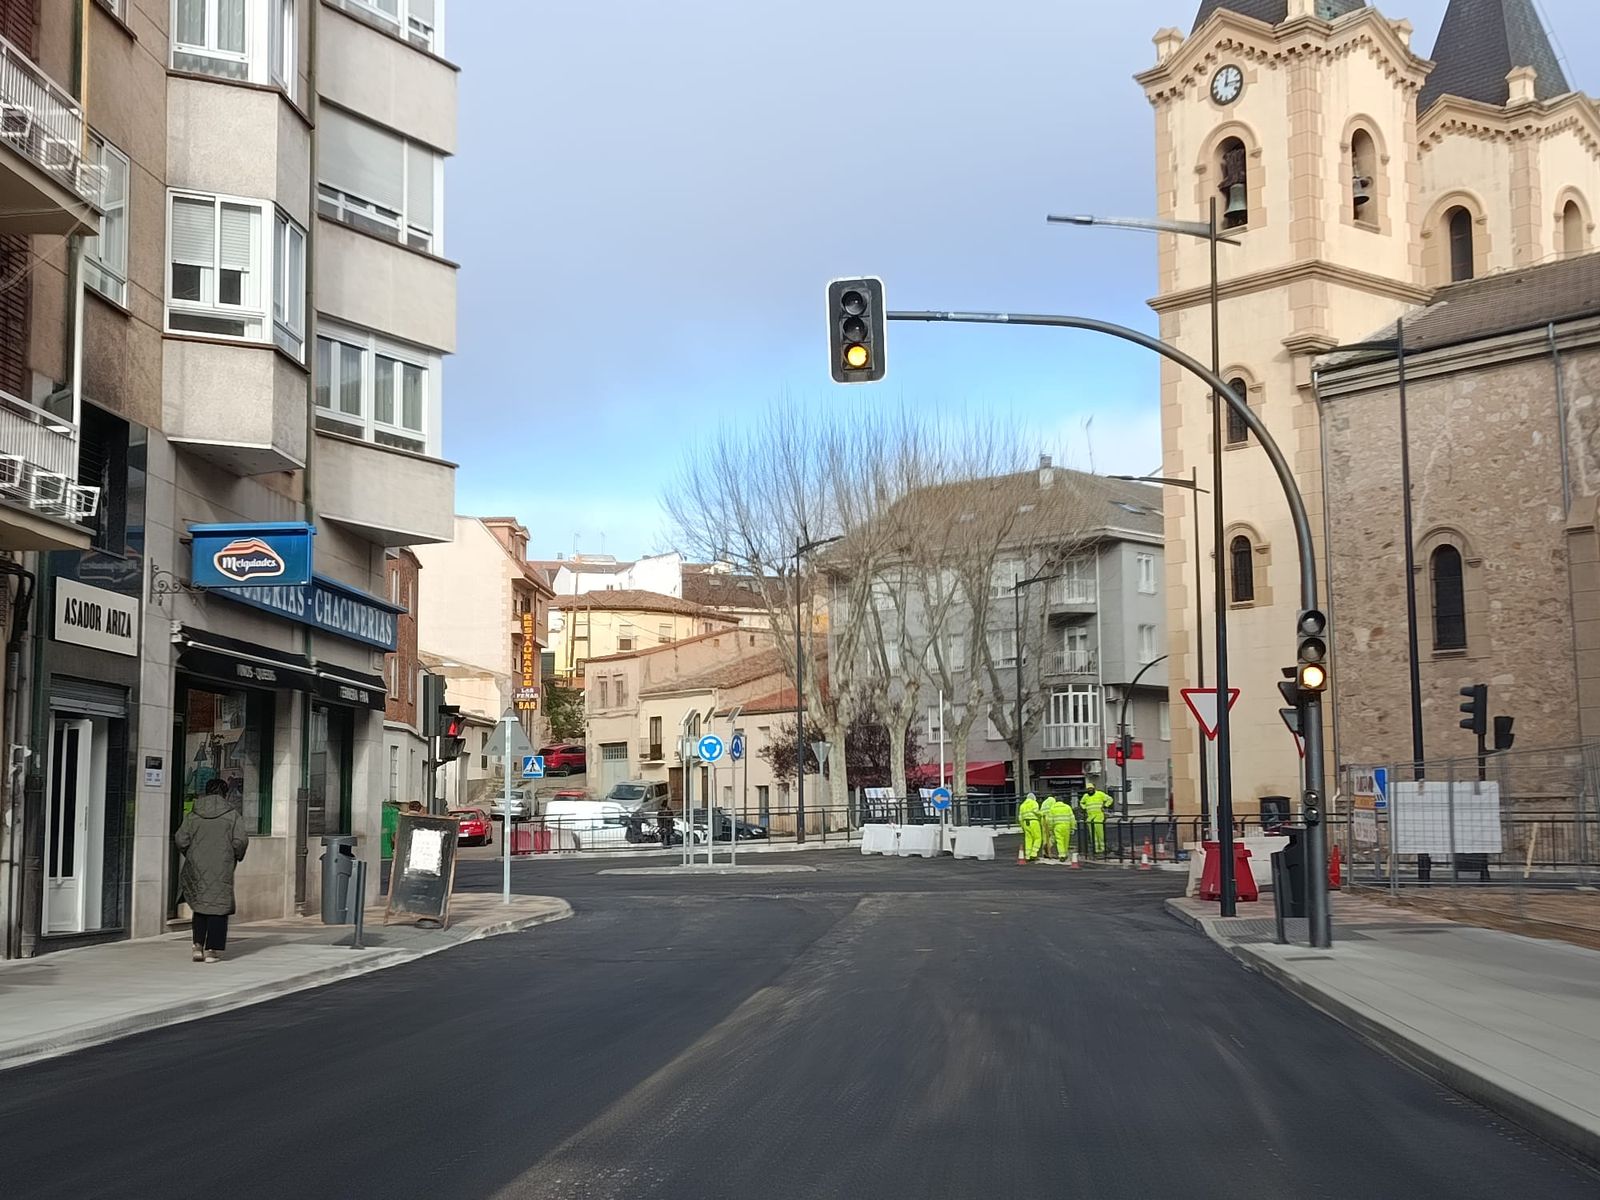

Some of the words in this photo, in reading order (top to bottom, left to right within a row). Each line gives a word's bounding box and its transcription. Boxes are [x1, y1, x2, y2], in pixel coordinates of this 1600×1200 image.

[64, 597, 102, 632] ASADOR
[106, 608, 132, 638] ARIZA
[315, 589, 392, 646] CHACINERIAS
[523, 614, 533, 686] RESTAURANTE
[518, 701, 536, 710] BAR
